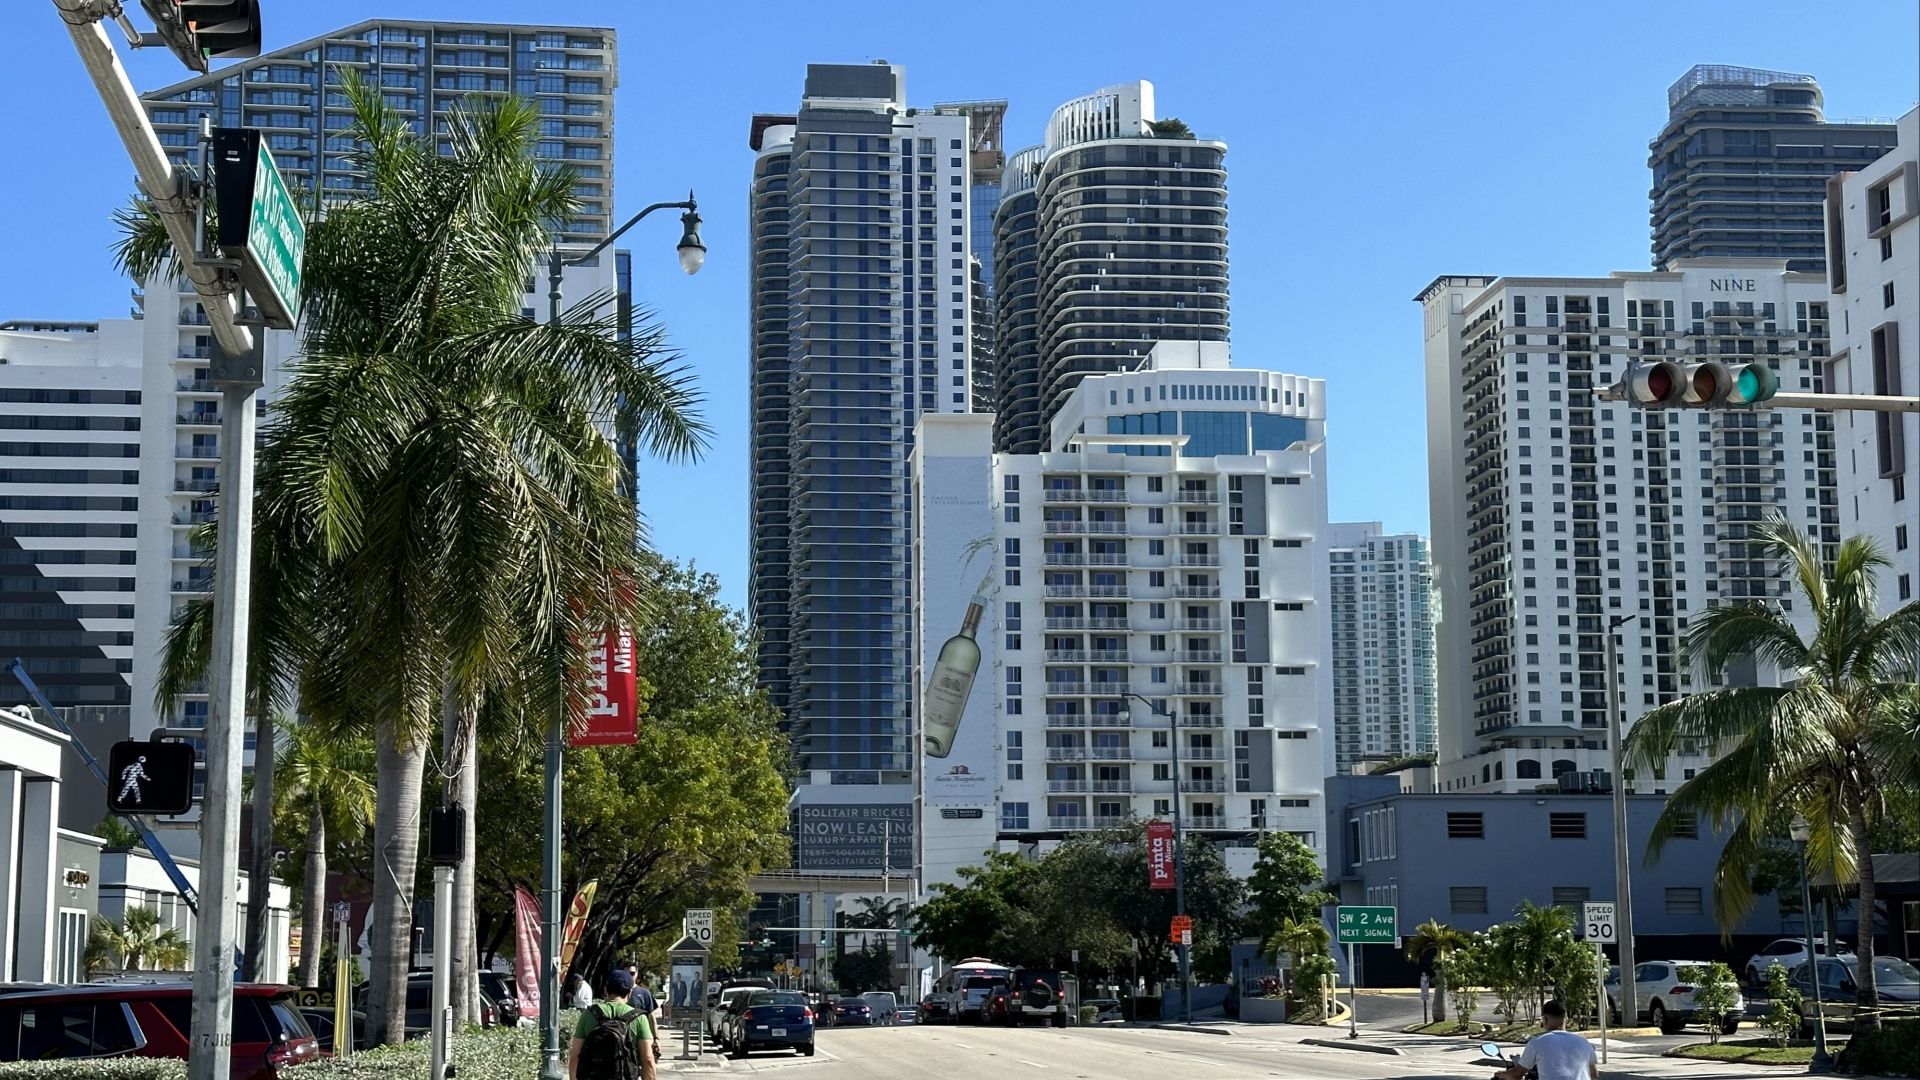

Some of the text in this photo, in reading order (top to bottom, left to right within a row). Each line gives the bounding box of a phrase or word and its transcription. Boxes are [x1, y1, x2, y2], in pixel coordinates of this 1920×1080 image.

[1709, 278, 1756, 292] NINE
[804, 808, 912, 818] SOLITAIR BRICKEL
[804, 822, 844, 835] NOW
[803, 836, 914, 844] LUXURY APARTENT
[804, 848, 826, 856] TEXT
[1164, 838, 1172, 862] Miami
[804, 857, 881, 865] LIVESOLITAIR.CO
[1151, 837, 1168, 879] pinta
[1340, 912, 1393, 924] SW 2 Ave
[690, 927, 711, 940] 30
[1588, 923, 1613, 938] 30
